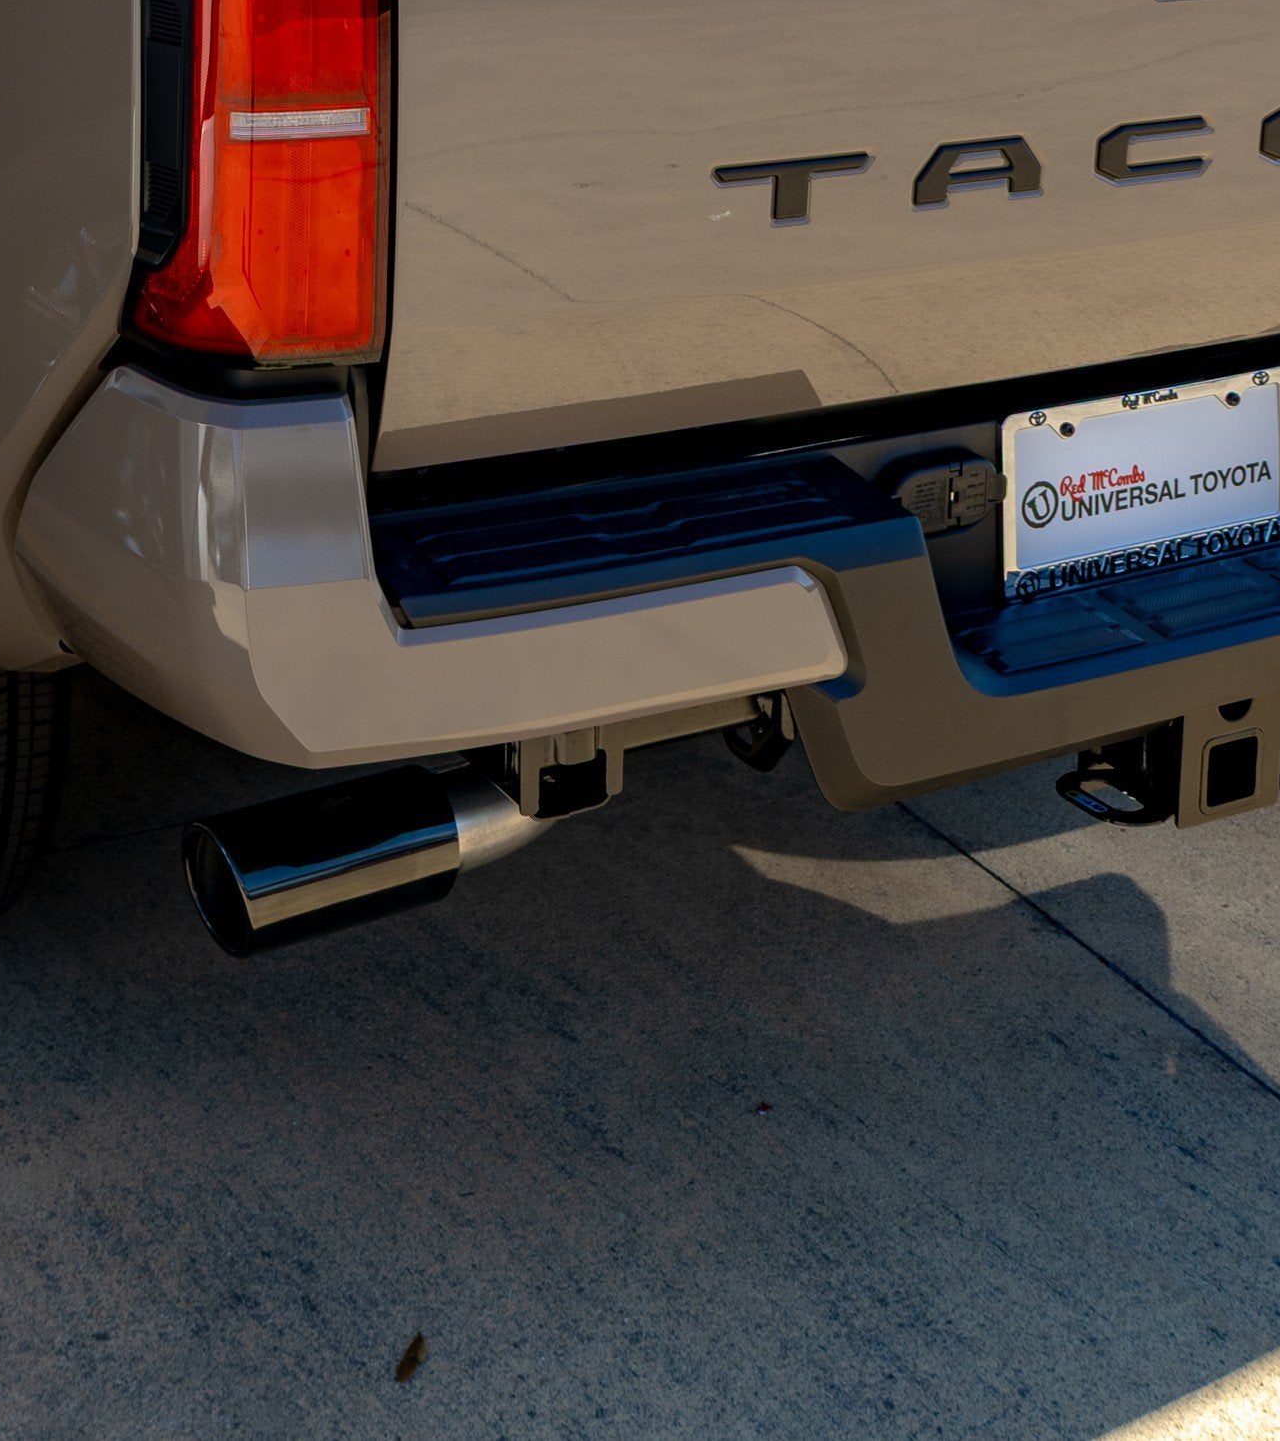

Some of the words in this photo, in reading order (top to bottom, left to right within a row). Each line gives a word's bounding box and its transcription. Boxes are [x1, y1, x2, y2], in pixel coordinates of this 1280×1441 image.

[1059, 474, 1086, 502] Red
[1088, 464, 1146, 490] McCombs
[1061, 478, 1186, 521] UNIVERSAL
[1189, 460, 1272, 495] TOYOTA
[1049, 538, 1188, 590] UNIVERSAL
